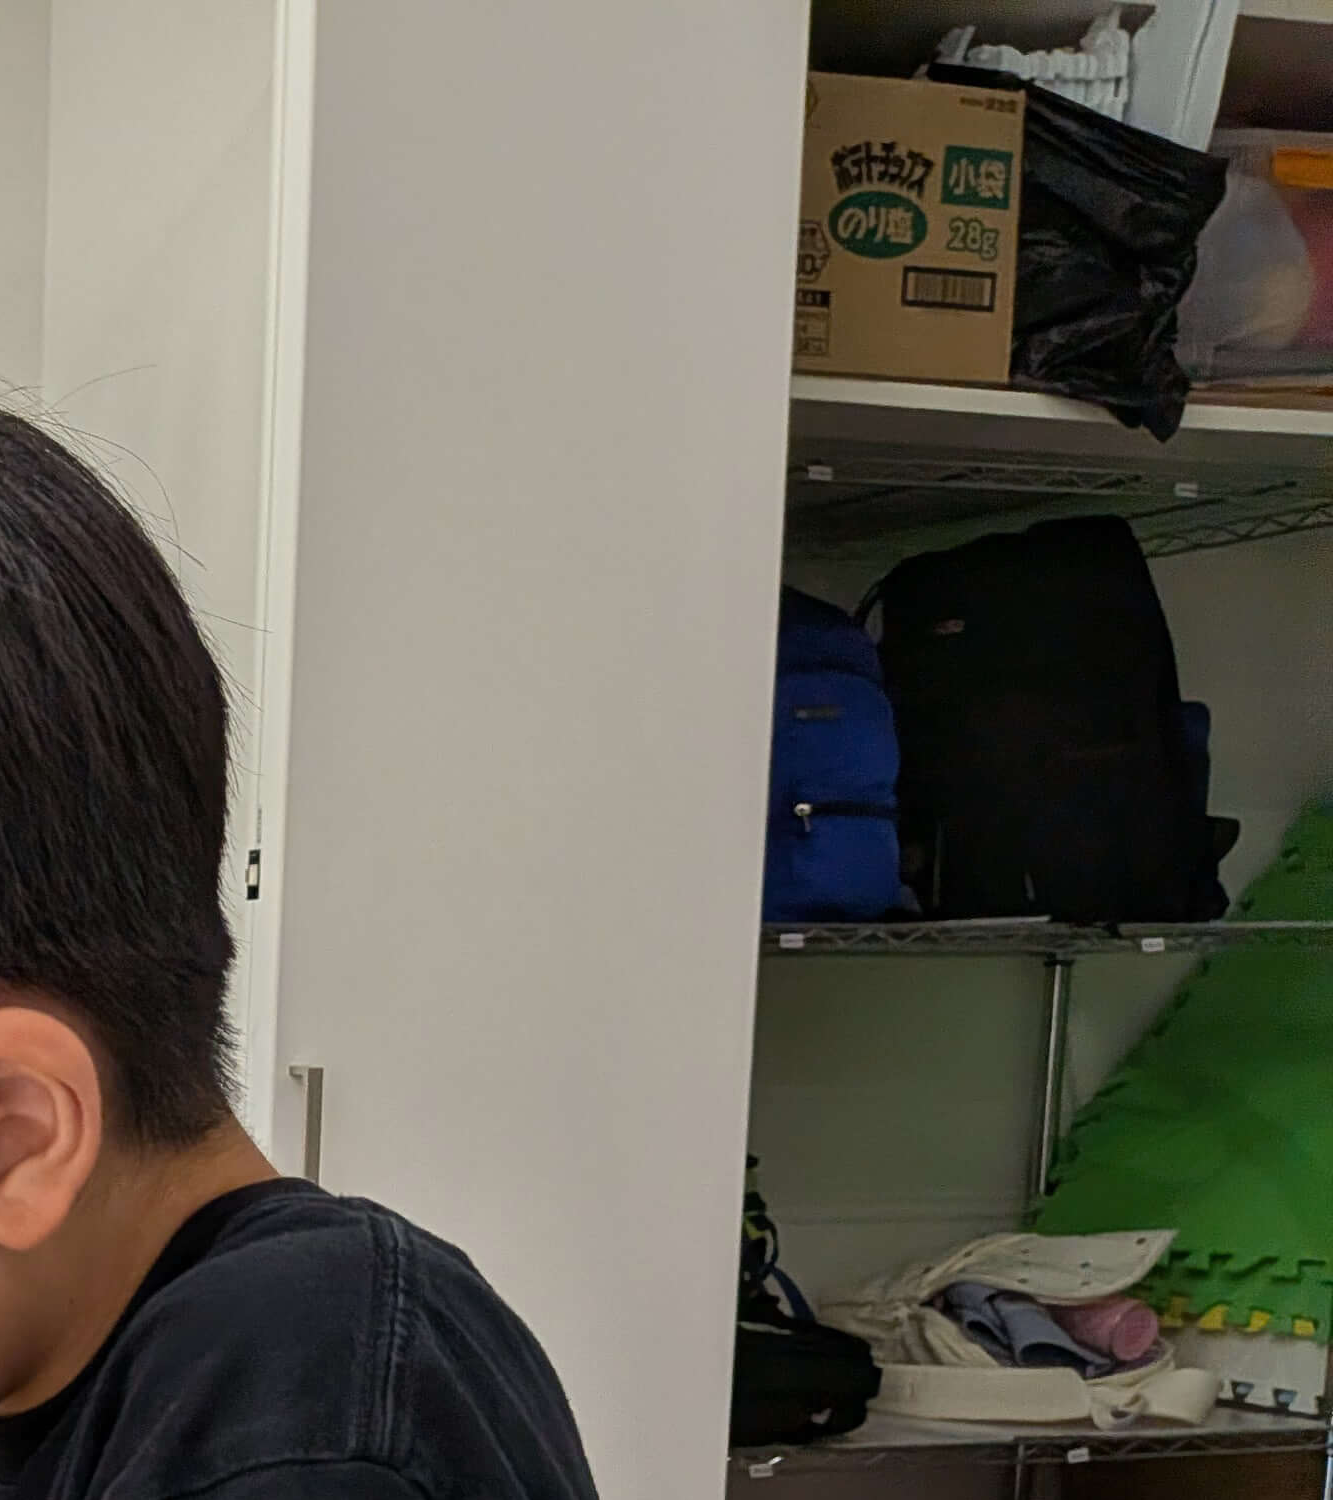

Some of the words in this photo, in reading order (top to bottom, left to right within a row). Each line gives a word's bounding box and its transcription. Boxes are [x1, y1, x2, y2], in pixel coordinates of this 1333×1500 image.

[949, 157, 1006, 200] 小袋
[837, 205, 914, 245] のり塩
[947, 217, 1000, 261] 28g
